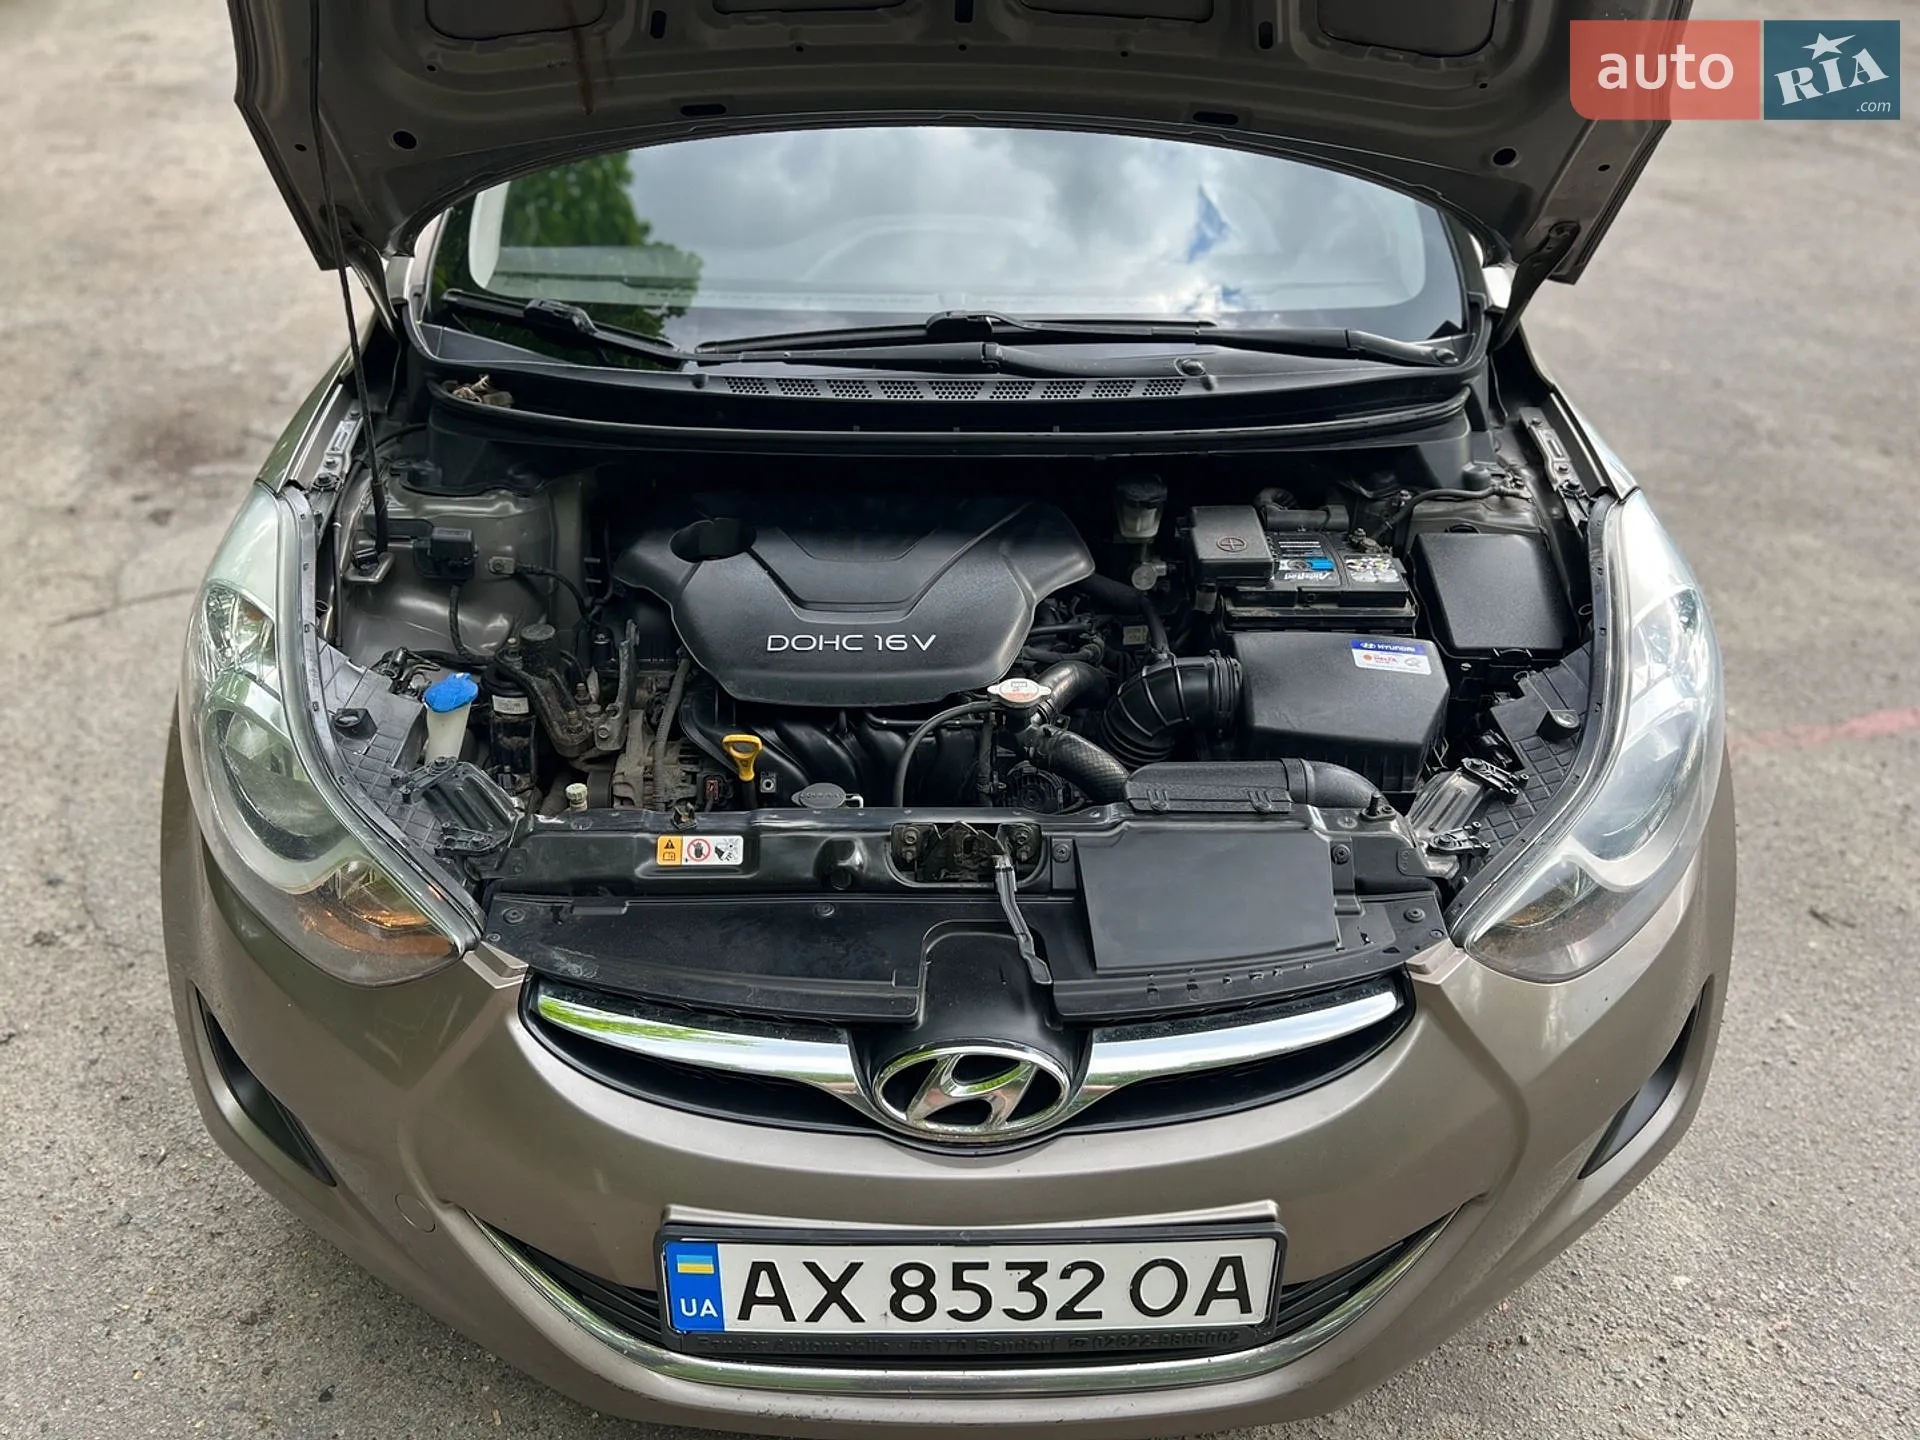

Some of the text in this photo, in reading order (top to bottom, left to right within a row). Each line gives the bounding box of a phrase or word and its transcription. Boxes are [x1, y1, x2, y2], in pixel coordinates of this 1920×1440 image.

[767, 634, 864, 651] DOHC
[736, 1254, 1254, 1324] AX 8532 OA
[680, 1298, 718, 1317] UA
